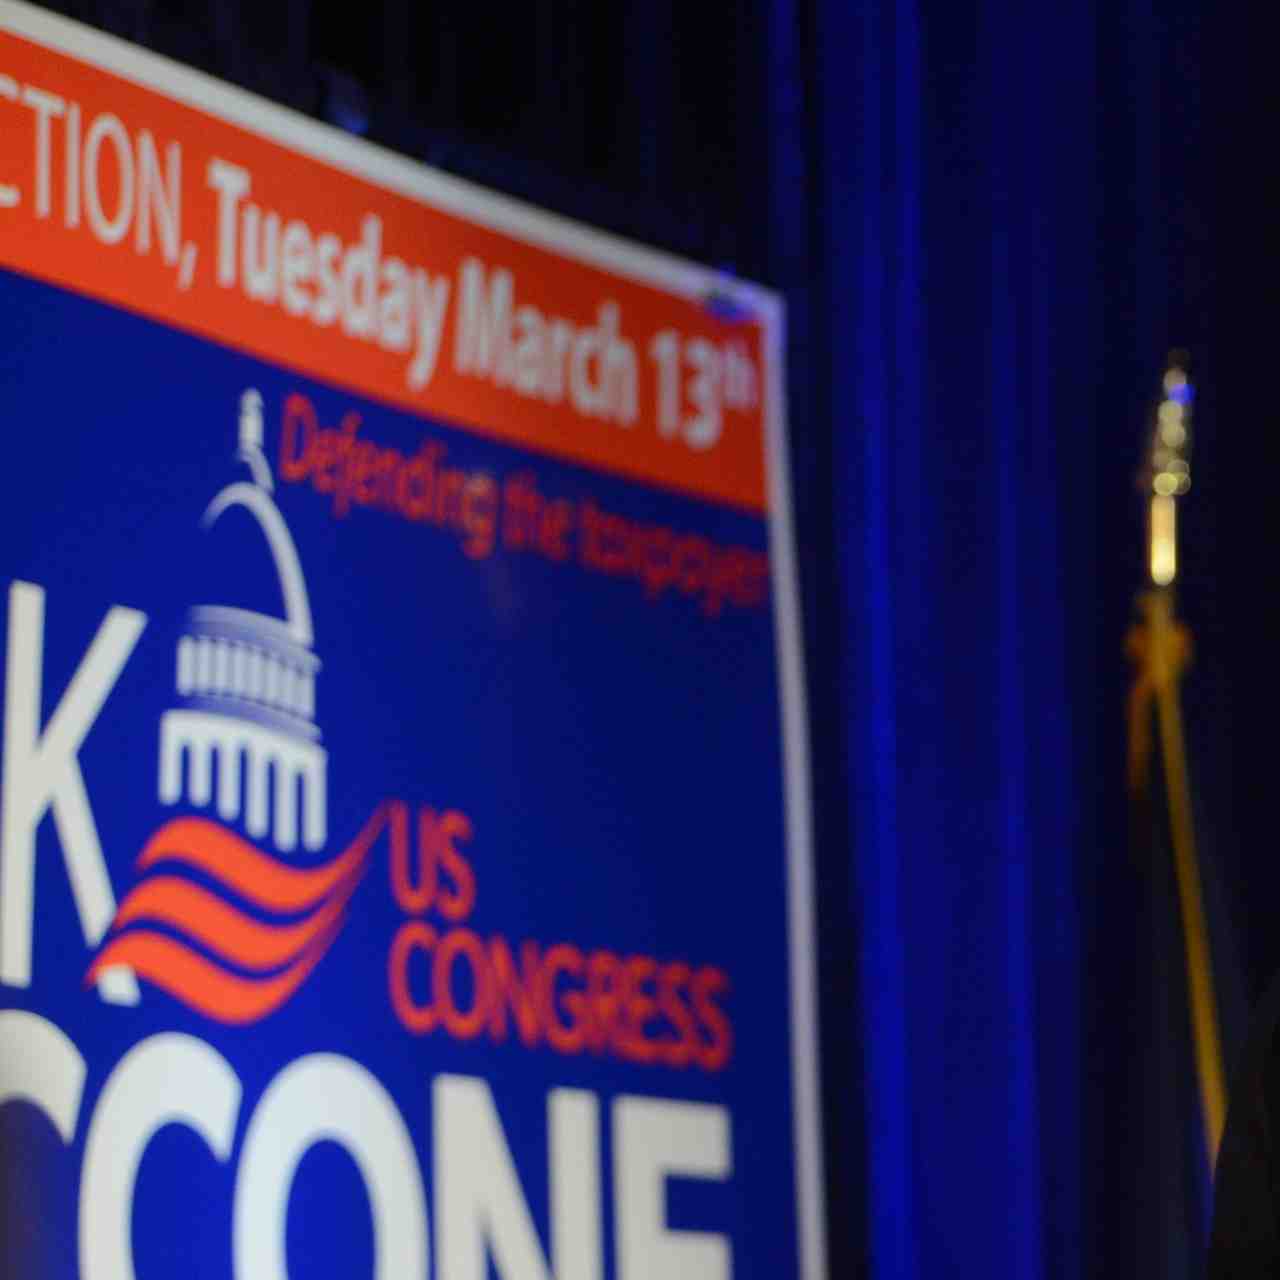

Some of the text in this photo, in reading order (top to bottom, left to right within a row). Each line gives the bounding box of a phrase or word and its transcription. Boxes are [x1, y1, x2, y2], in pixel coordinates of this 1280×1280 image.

[208, 158, 450, 391] Tuesday
[456, 257, 639, 428] March
[649, 328, 757, 449] 13th
[280, 393, 498, 560] Defending
[504, 470, 571, 561] the
[389, 798, 476, 922] US
[389, 920, 733, 1071] CONGRESS
